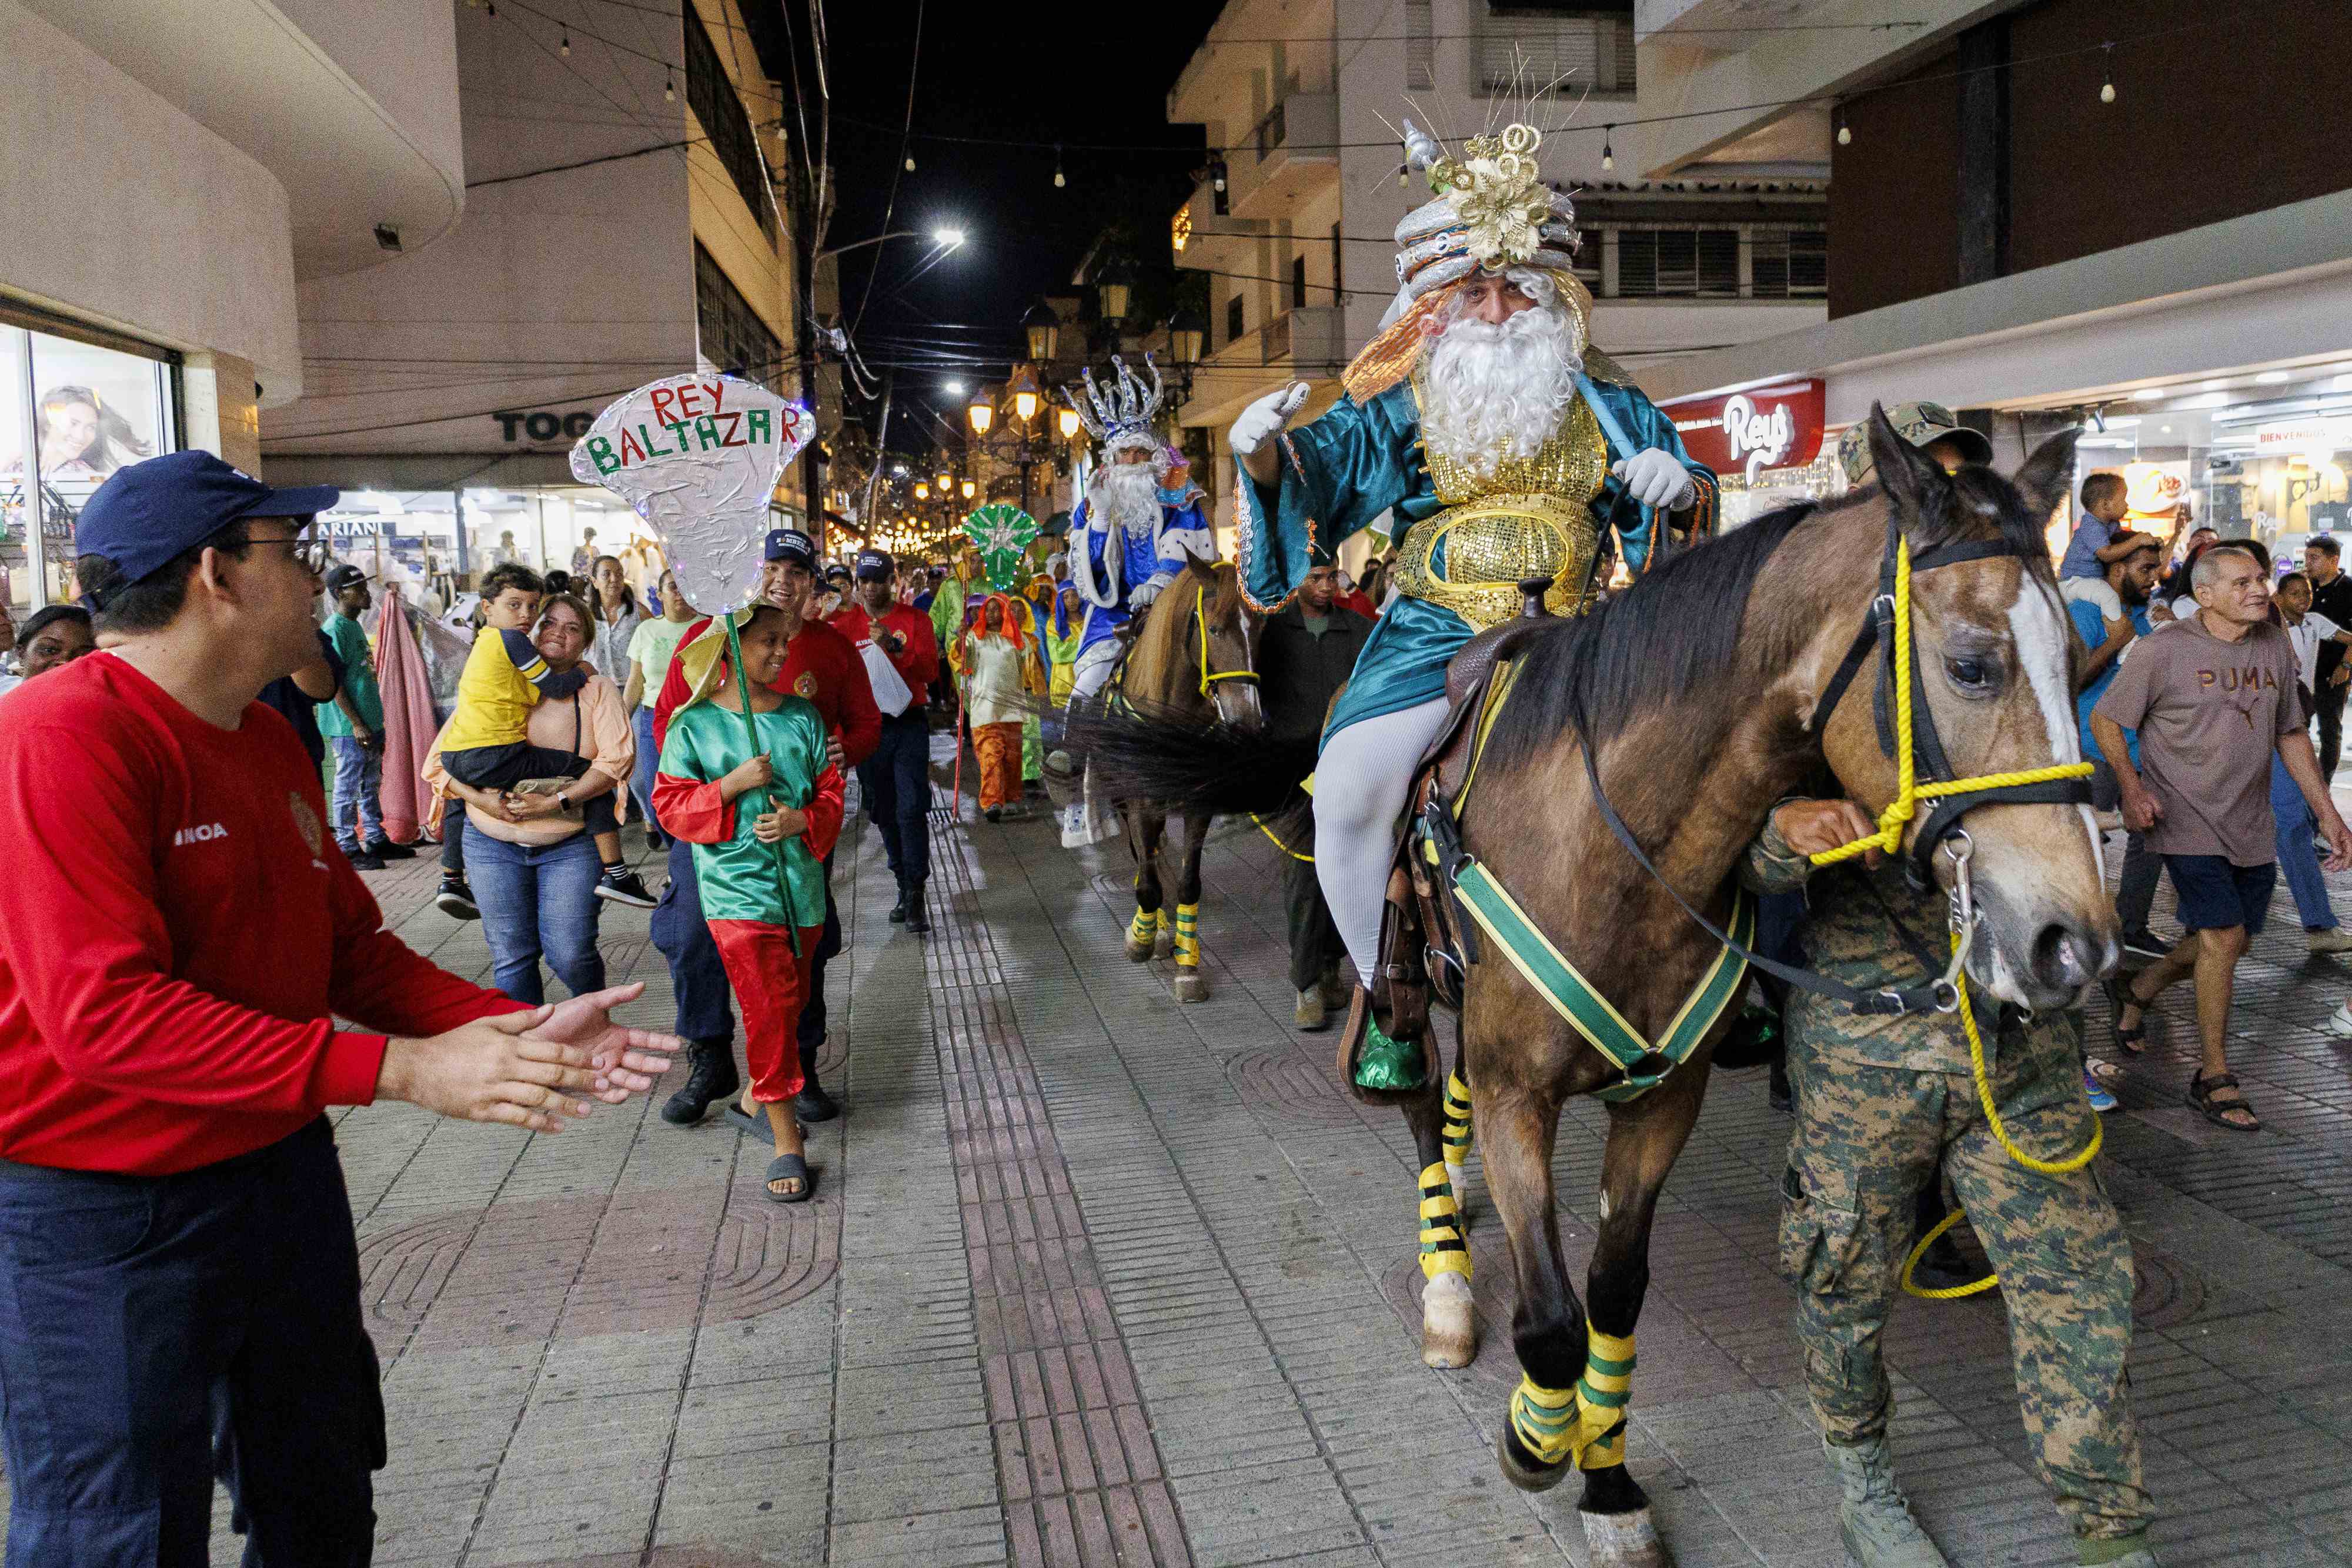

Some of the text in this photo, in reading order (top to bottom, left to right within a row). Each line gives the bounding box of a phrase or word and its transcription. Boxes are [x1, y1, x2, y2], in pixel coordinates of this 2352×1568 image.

[650, 381, 724, 427] REY
[586, 407, 800, 476] BALTAZAR
[2196, 667, 2278, 693] PUMA
